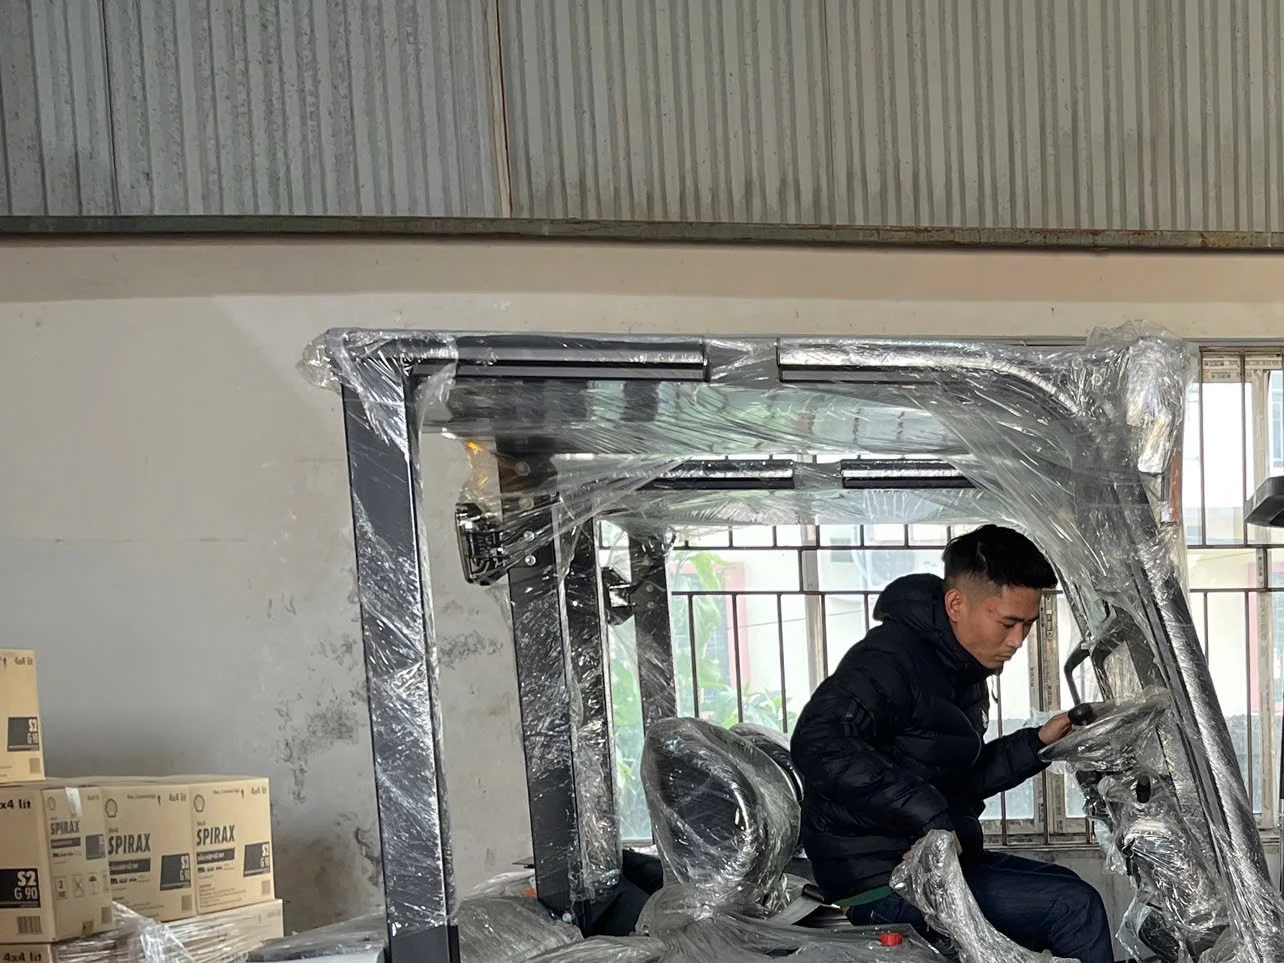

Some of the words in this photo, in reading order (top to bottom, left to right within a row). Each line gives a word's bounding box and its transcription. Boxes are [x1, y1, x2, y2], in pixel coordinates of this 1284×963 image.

[18, 799, 31, 809] lit
[50, 820, 80, 836] SPIRAX
[196, 825, 235, 846] SPIRAX
[107, 832, 151, 855] SPIRAX
[17, 870, 37, 887] S2
[14, 886, 22, 900] G
[24, 886, 38, 900] 90
[3, 952, 26, 962] 4x4
[29, 952, 42, 962] lit
